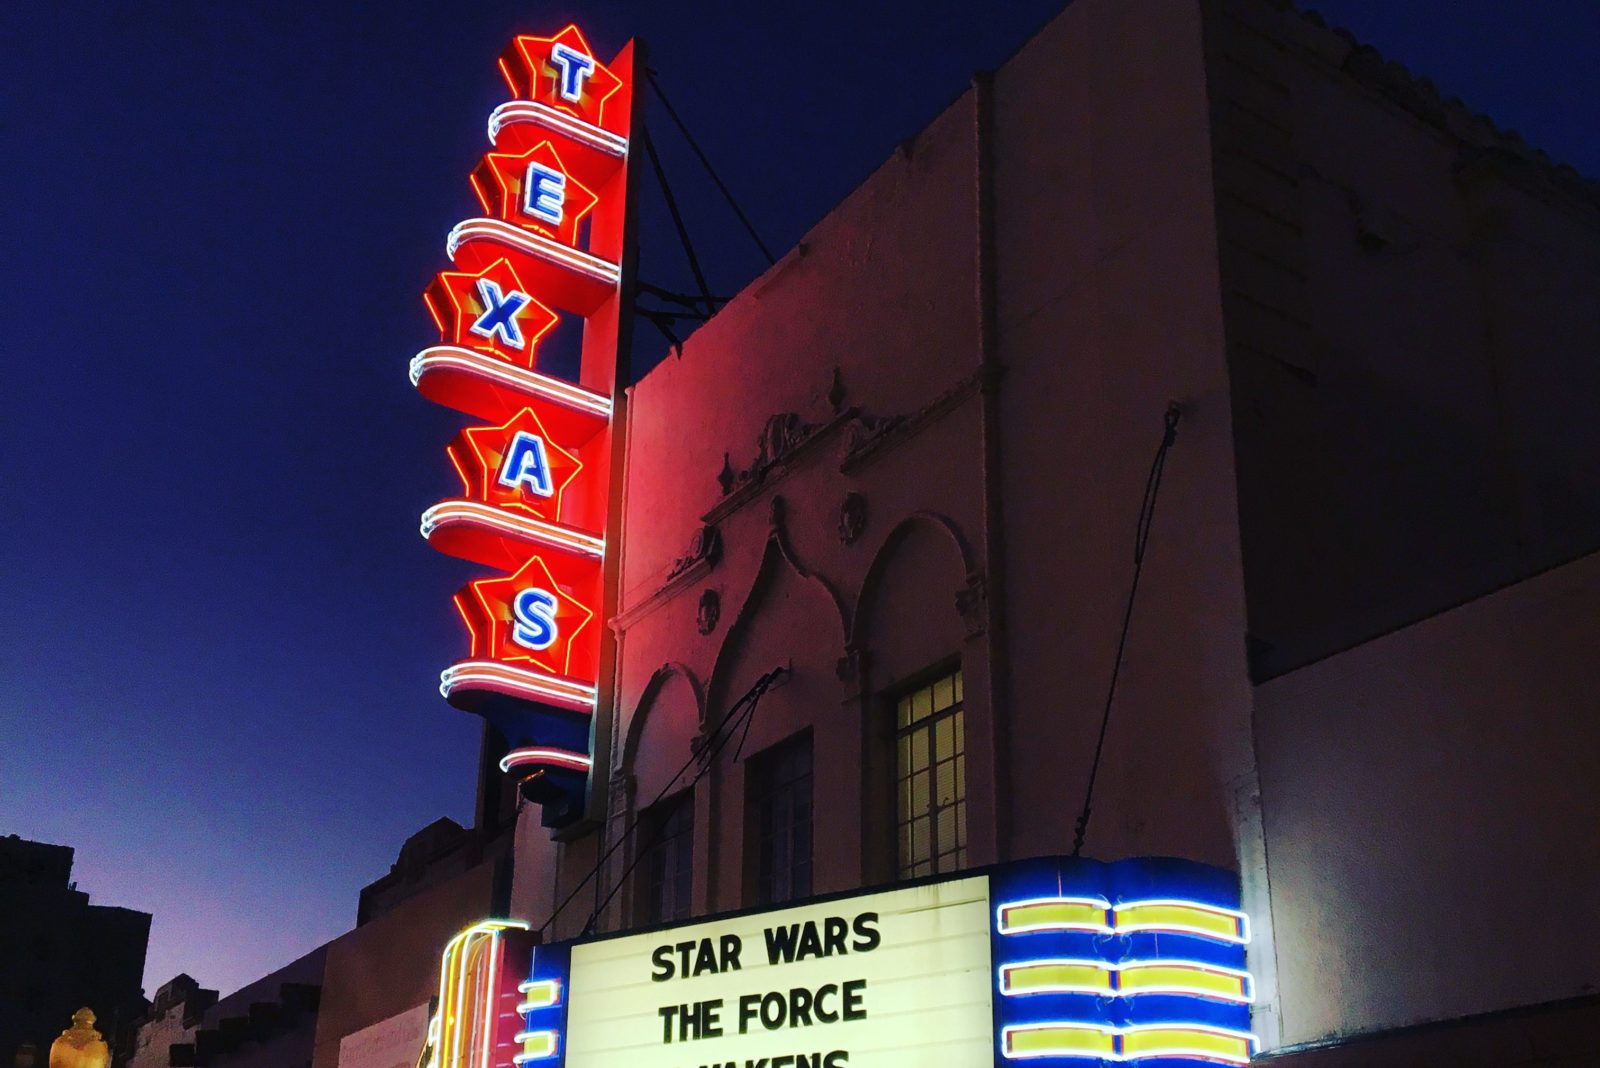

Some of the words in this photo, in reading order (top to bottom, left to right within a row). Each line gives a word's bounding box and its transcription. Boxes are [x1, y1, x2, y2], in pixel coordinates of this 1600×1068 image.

[469, 42, 596, 650] TEXAS
[651, 933, 742, 982] STAR
[763, 911, 881, 966] WARS
[658, 998, 723, 1044] THE
[738, 978, 867, 1035] FORCE
